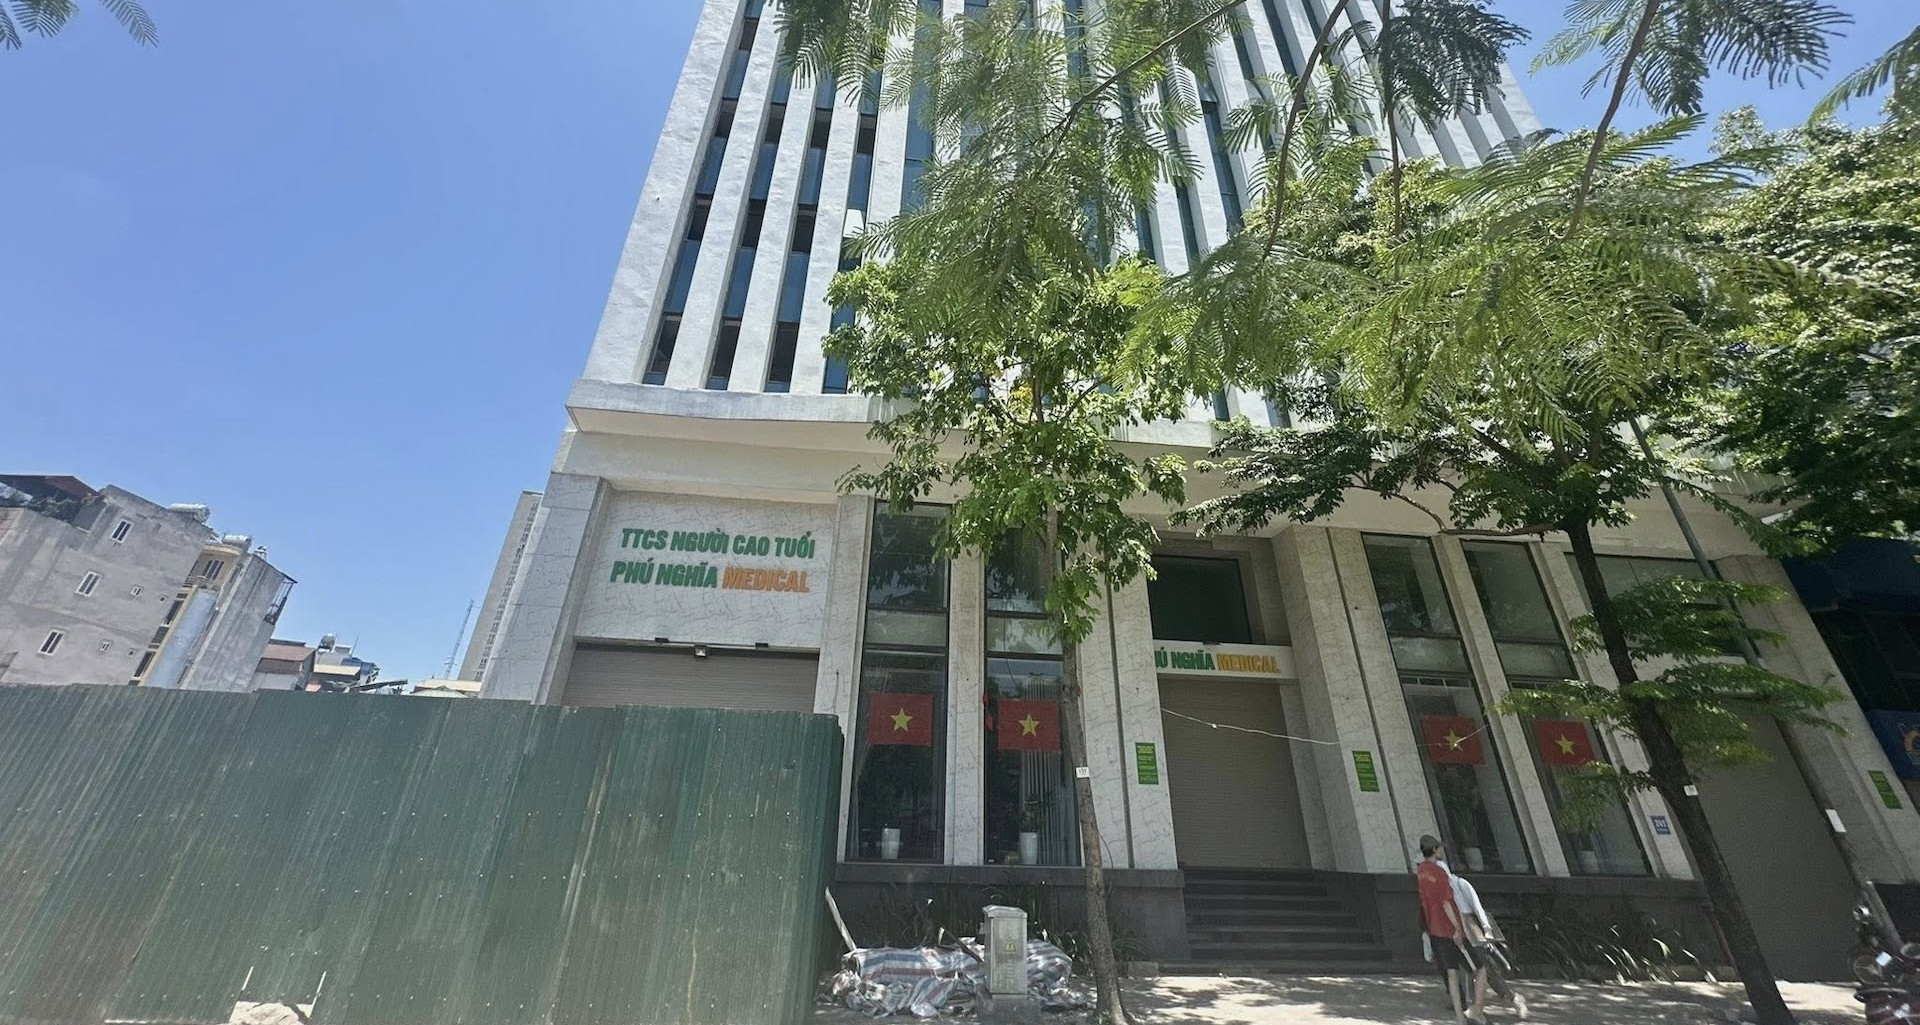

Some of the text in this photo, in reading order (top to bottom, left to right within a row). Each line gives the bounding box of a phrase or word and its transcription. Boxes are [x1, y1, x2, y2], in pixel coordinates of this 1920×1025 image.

[621, 528, 816, 558] TTCS NGƯỜI CAO TUỔI
[610, 557, 810, 592] PHÚ NGHĨA MEDICAL
[1170, 649, 1215, 670] NGHĨA
[1217, 653, 1280, 673] MEDICAL
